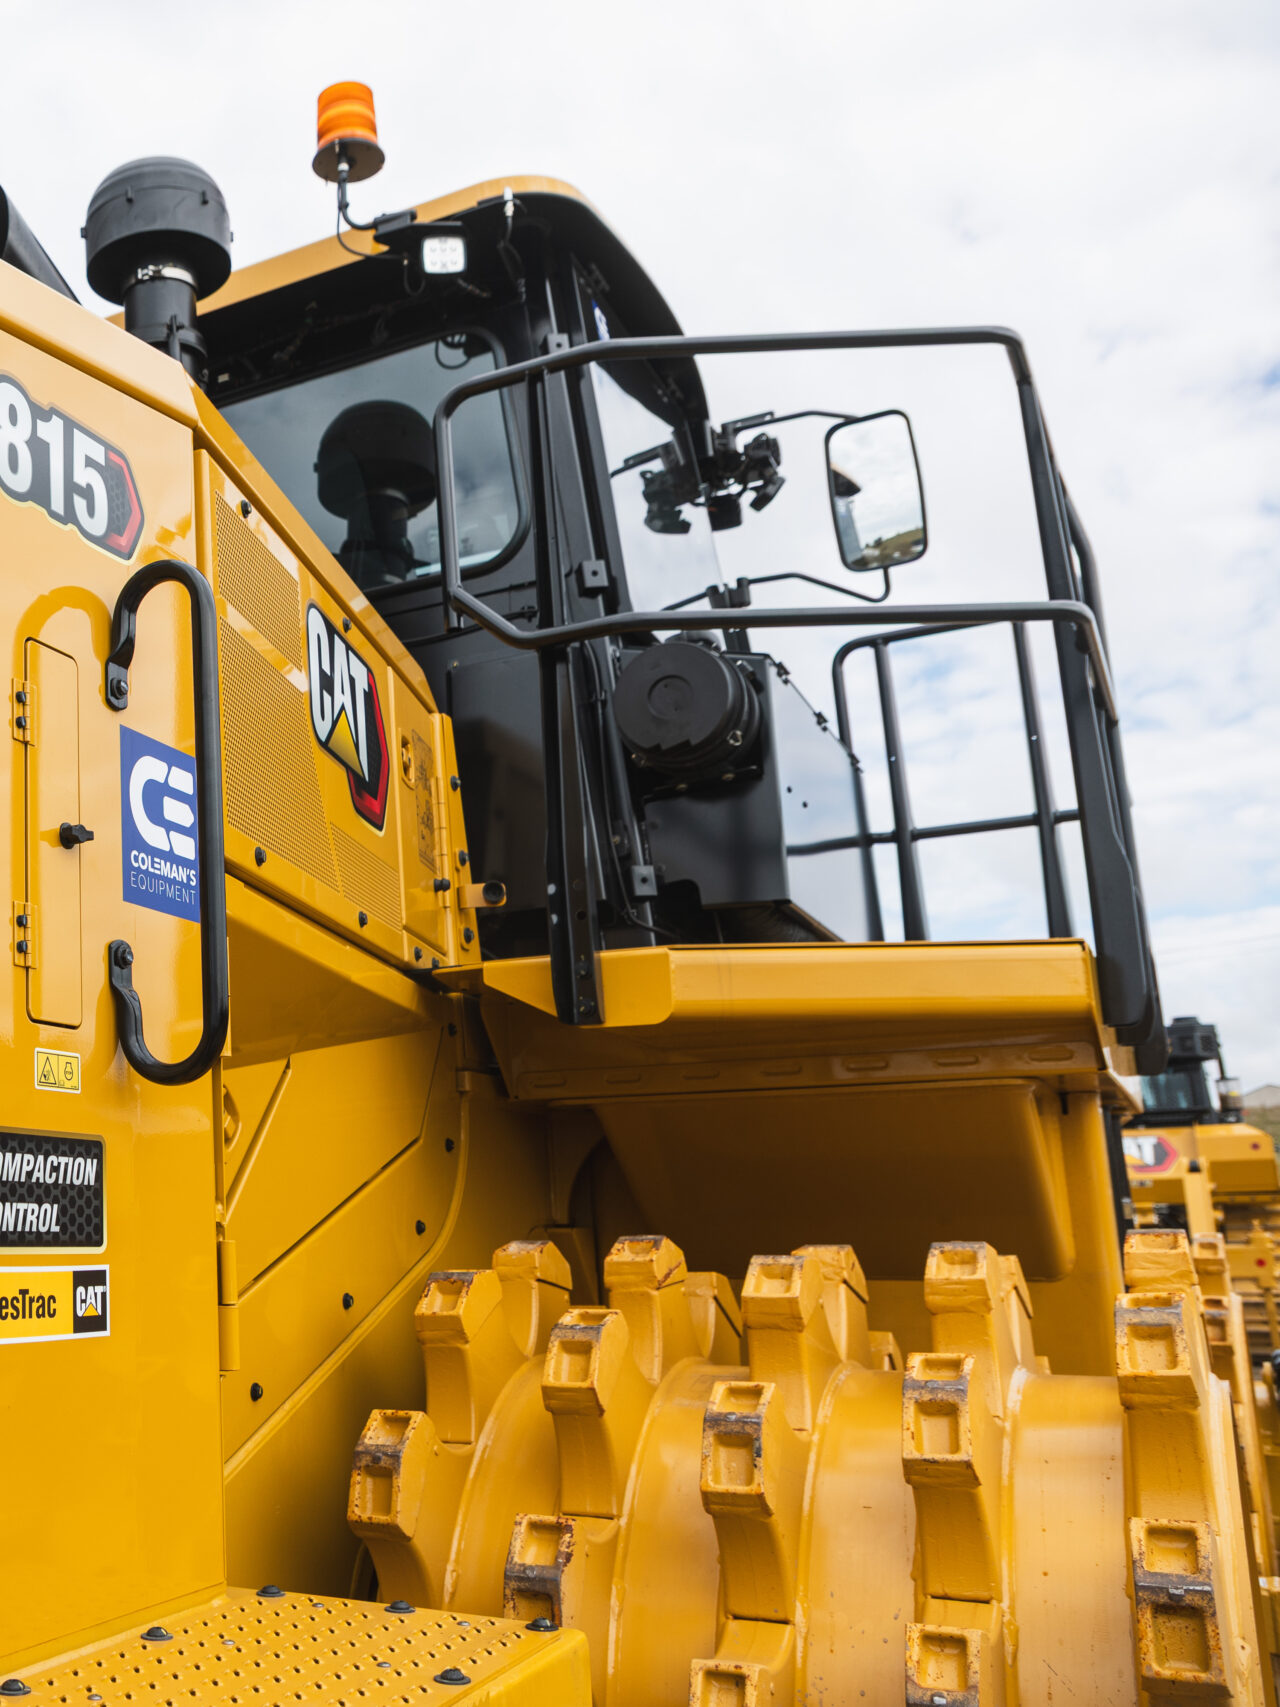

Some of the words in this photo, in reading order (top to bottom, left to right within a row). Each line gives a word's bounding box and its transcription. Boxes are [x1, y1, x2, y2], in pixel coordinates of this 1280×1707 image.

[308, 607, 369, 783] CAT
[130, 850, 197, 887] COLEMAN'S
[130, 871, 196, 905] EQUIPMENT
[1121, 1136, 1159, 1166] AT
[76, 1285, 104, 1318] CAT
